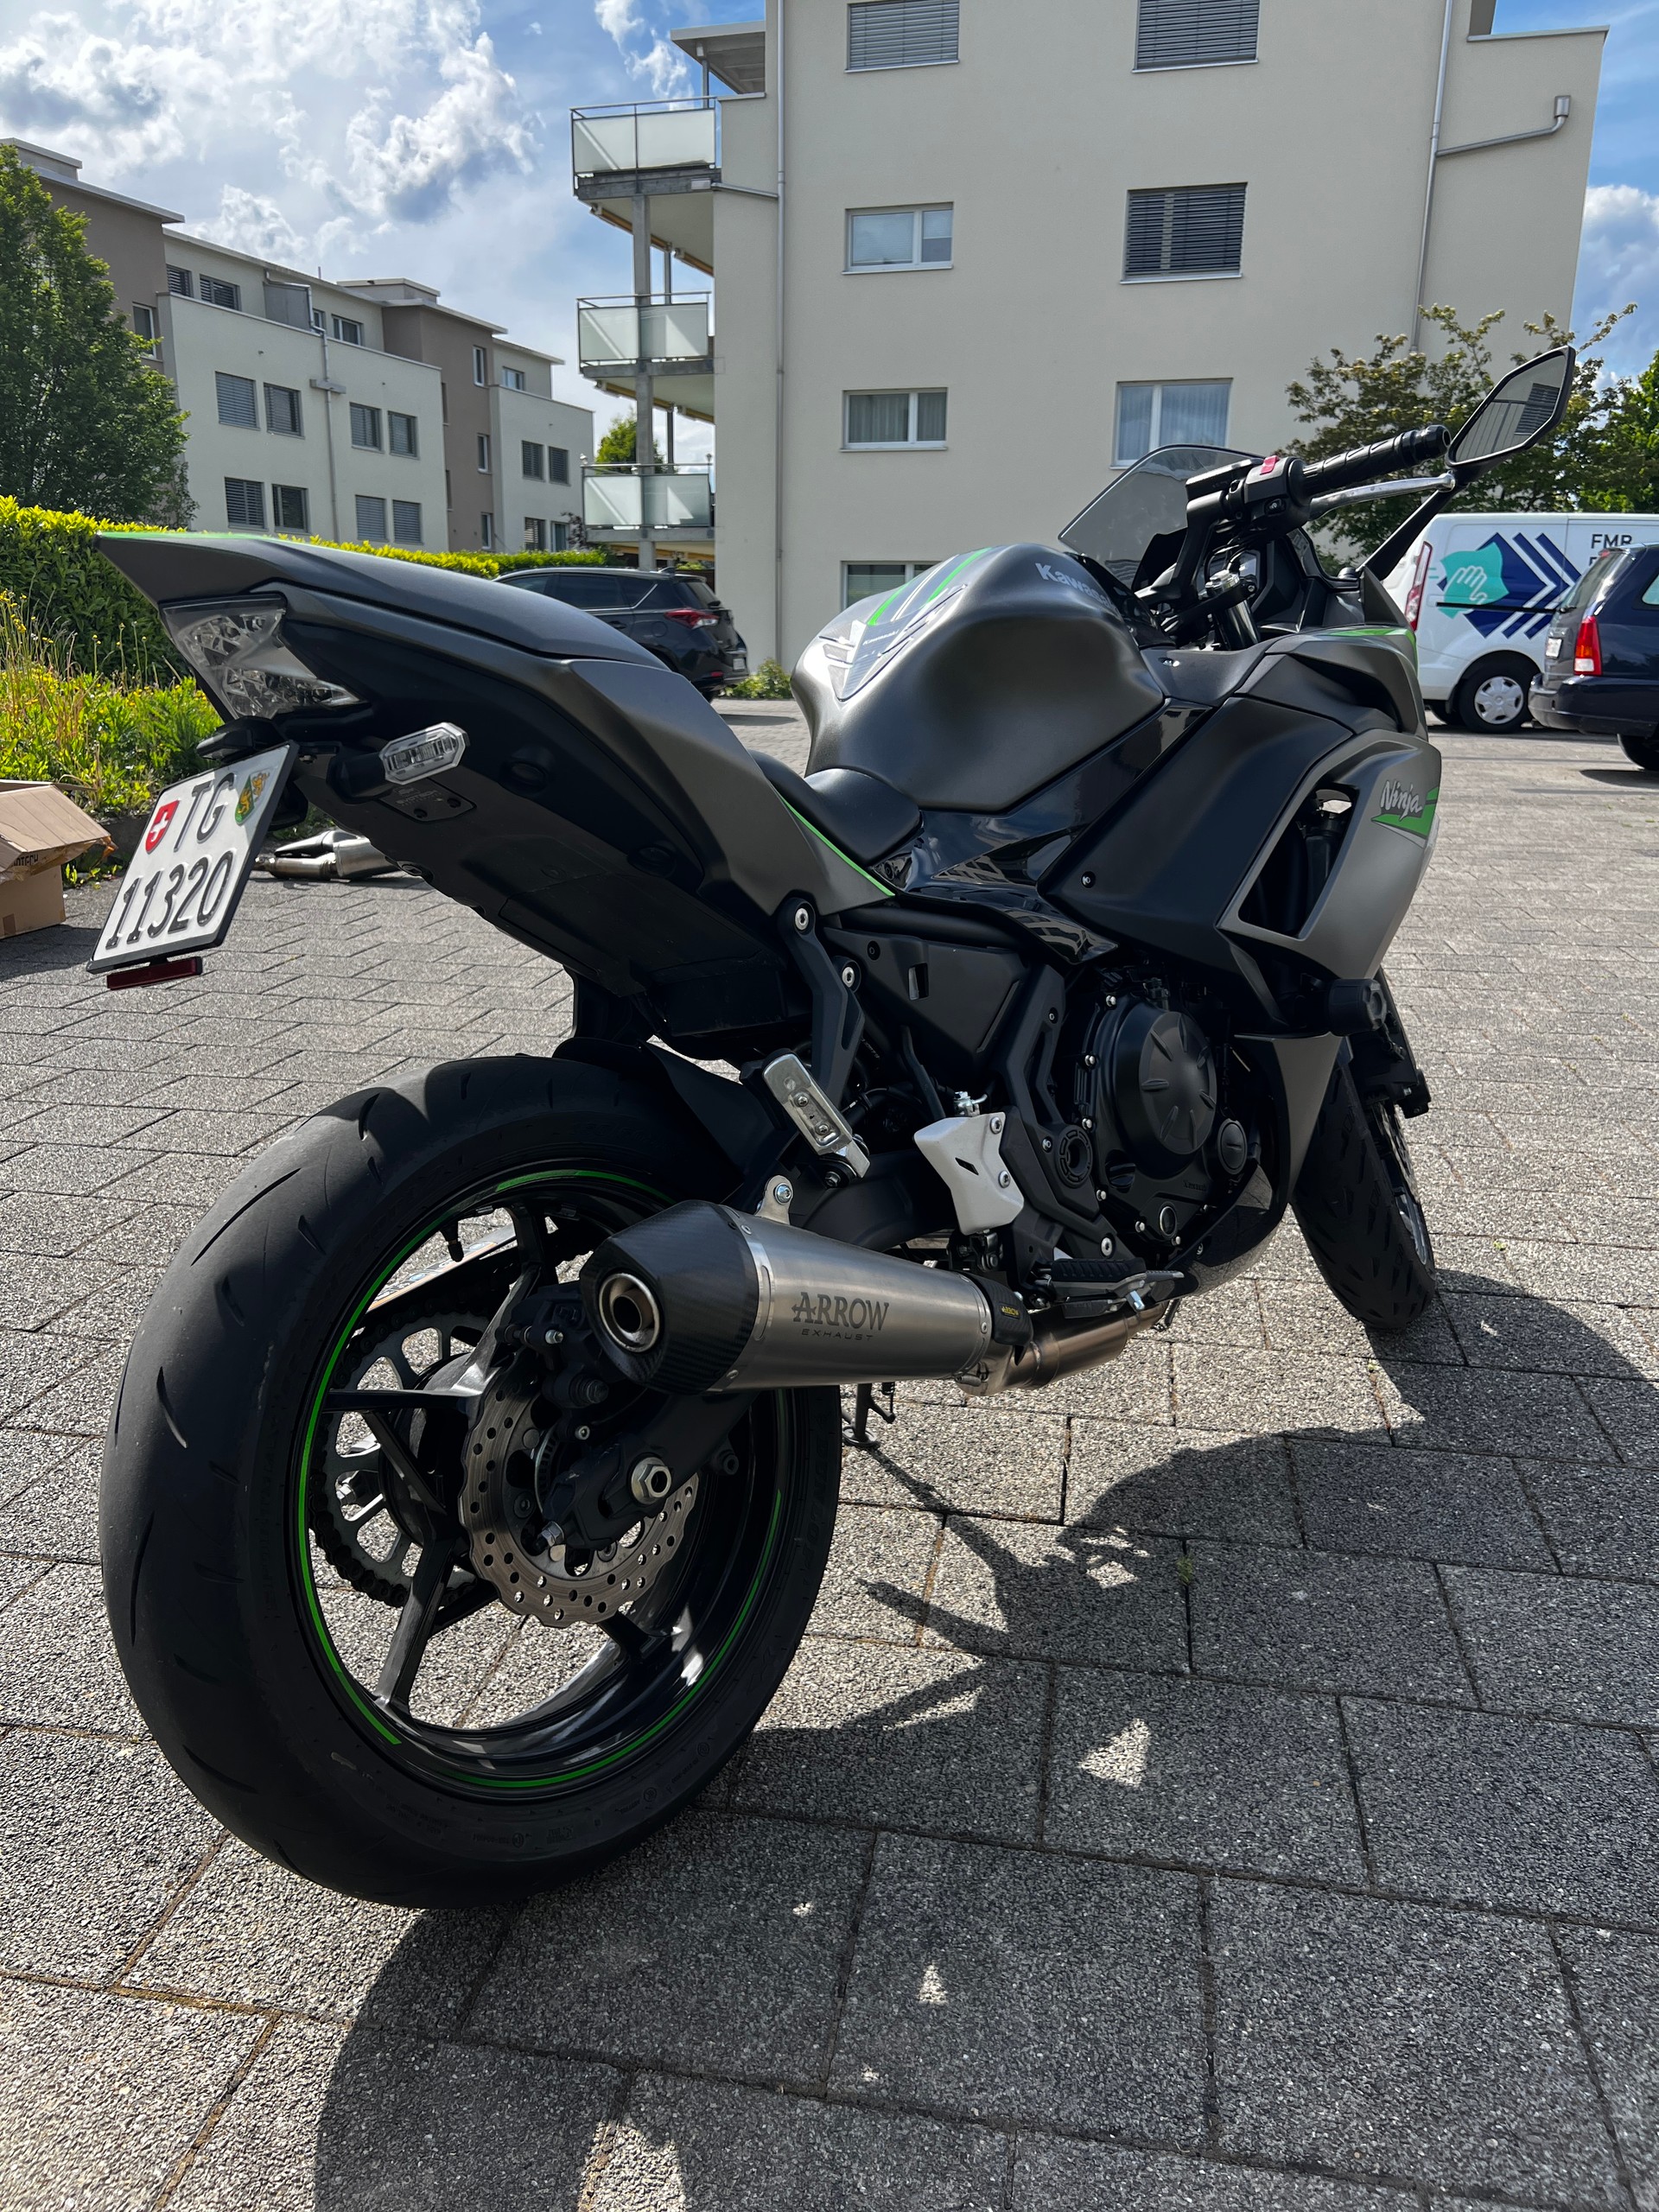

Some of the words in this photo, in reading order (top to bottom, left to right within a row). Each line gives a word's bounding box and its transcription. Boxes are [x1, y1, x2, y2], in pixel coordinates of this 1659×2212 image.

[174, 772, 236, 852] TG
[1380, 779, 1423, 822] Ninja
[105, 849, 236, 950] 11320
[791, 1292, 889, 1331] ARROW
[802, 1329, 874, 1341] EXHAUST
